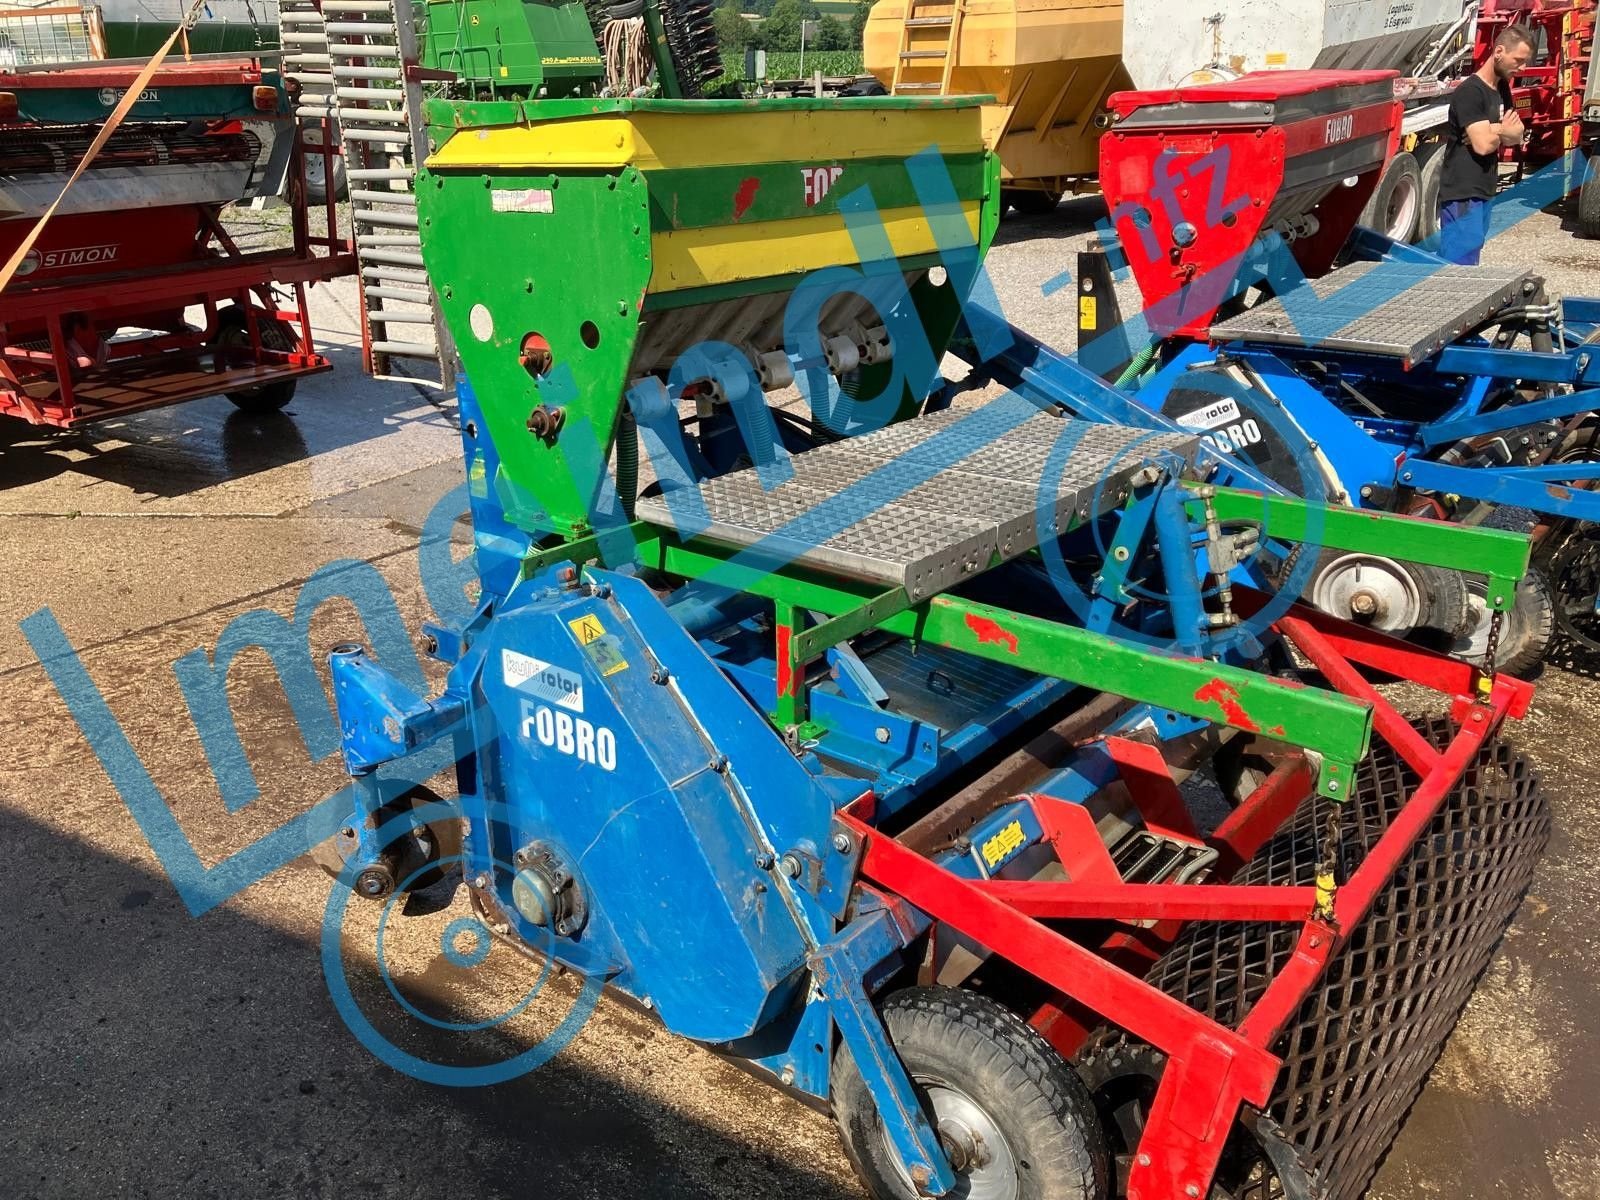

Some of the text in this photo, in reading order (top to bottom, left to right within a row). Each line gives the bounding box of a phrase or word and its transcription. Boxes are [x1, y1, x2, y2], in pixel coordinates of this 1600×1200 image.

[117, 90, 159, 102] SON
[1324, 114, 1354, 145] FOBRO
[43, 246, 118, 267] SIMON
[519, 698, 618, 771] FOBRO
